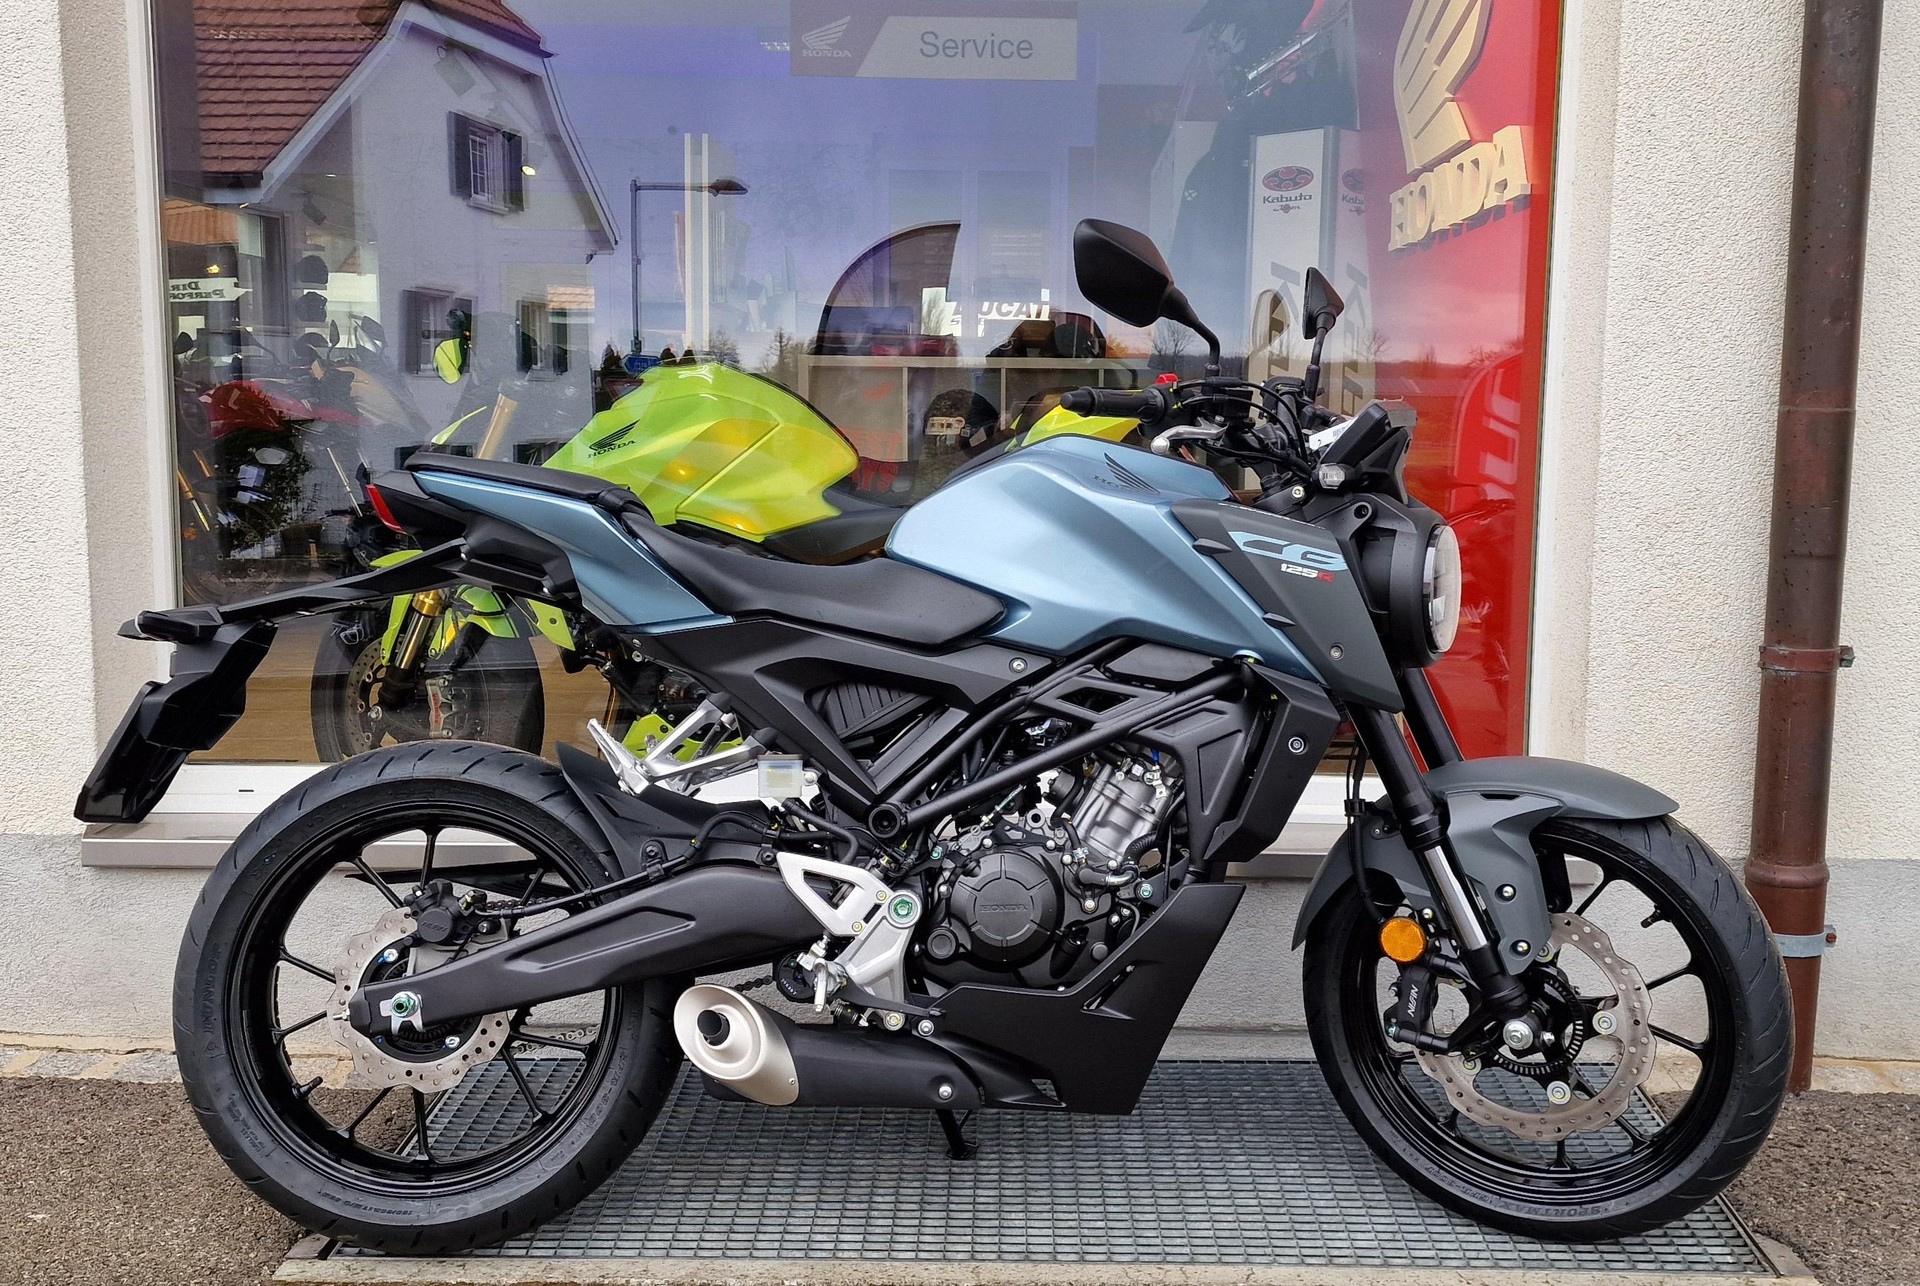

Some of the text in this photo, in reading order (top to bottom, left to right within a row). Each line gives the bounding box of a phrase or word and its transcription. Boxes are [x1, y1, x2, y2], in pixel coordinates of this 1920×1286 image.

[802, 49, 852, 57] HONDA
[919, 30, 1034, 60] Service
[1388, 125, 1531, 251] HONDA
[1262, 192, 1312, 204] Kabuto
[587, 440, 636, 458] HONDA
[1227, 531, 1349, 572] CB
[979, 903, 1028, 913] HONDA
